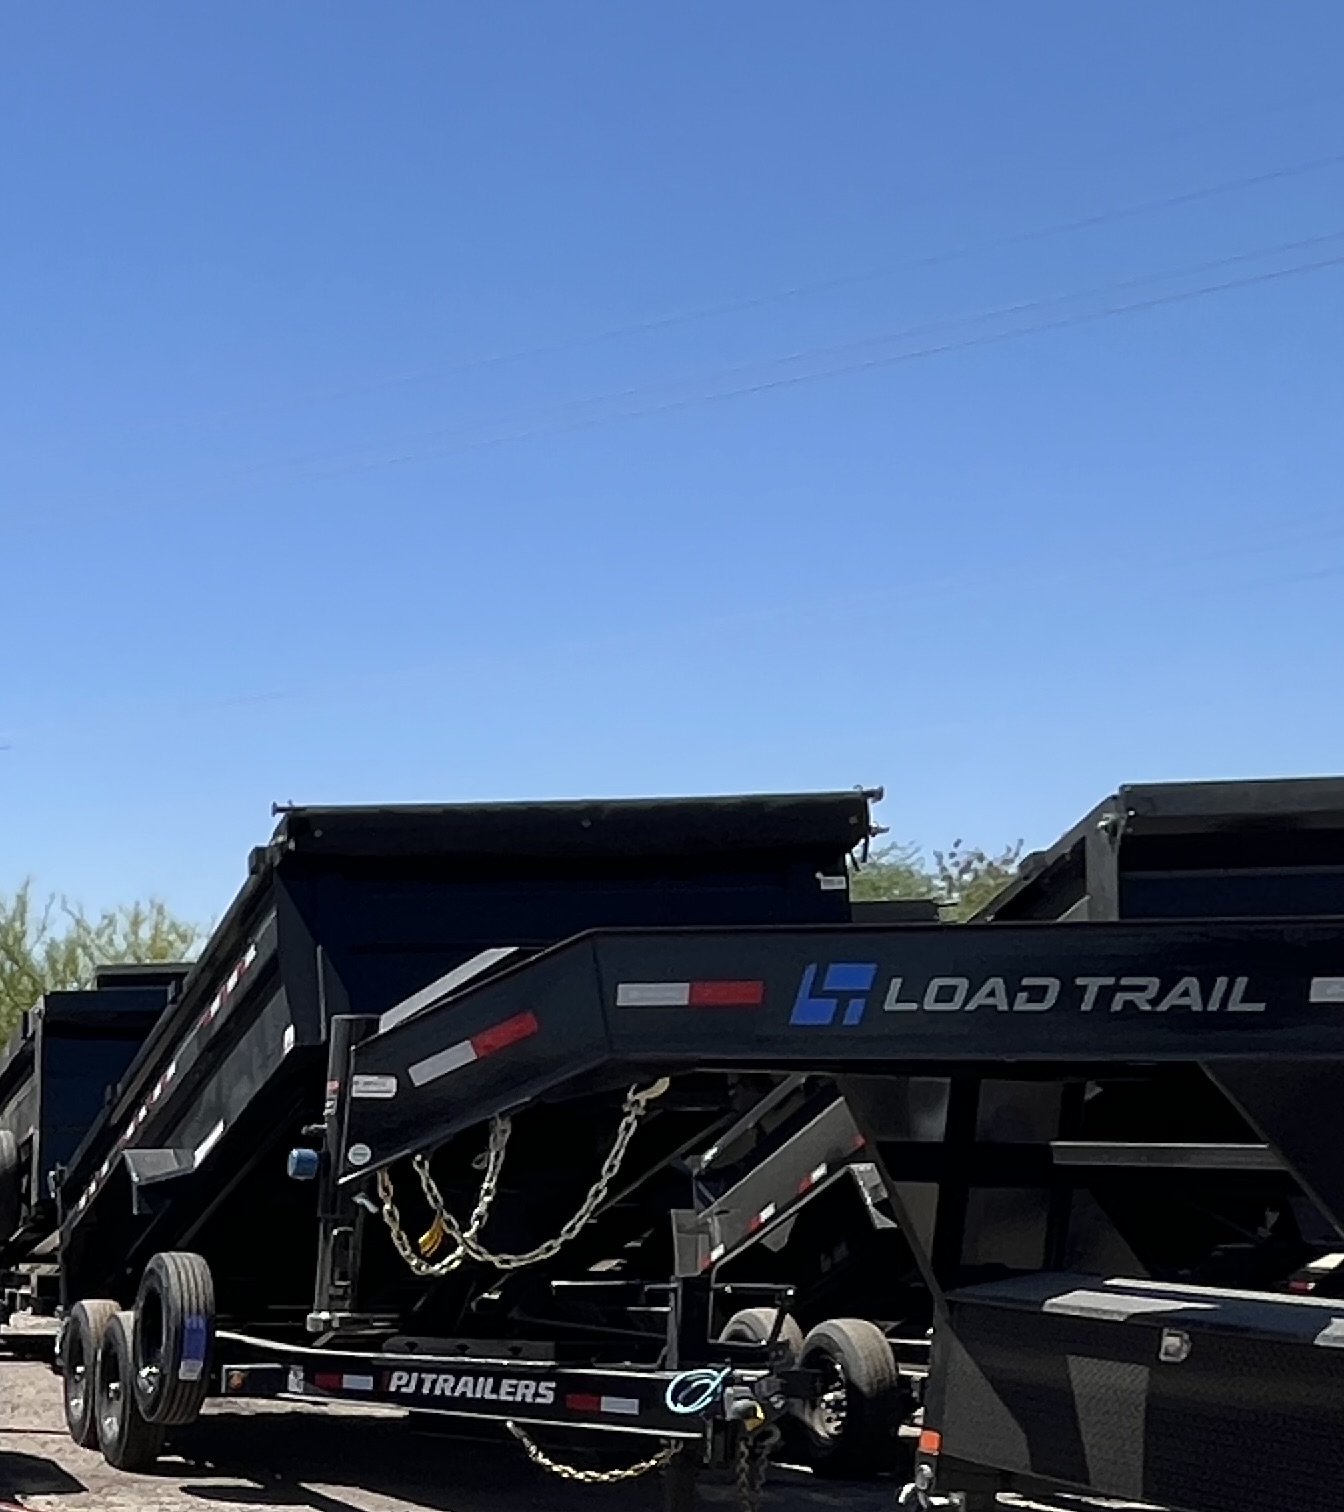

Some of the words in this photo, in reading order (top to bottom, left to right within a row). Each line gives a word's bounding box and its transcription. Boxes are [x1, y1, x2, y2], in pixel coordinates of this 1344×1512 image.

[883, 977, 1062, 1012] LOAD
[1074, 977, 1267, 1012] TRAIL
[389, 1371, 419, 1393] PJ
[421, 1374, 556, 1404] TRAILERS
